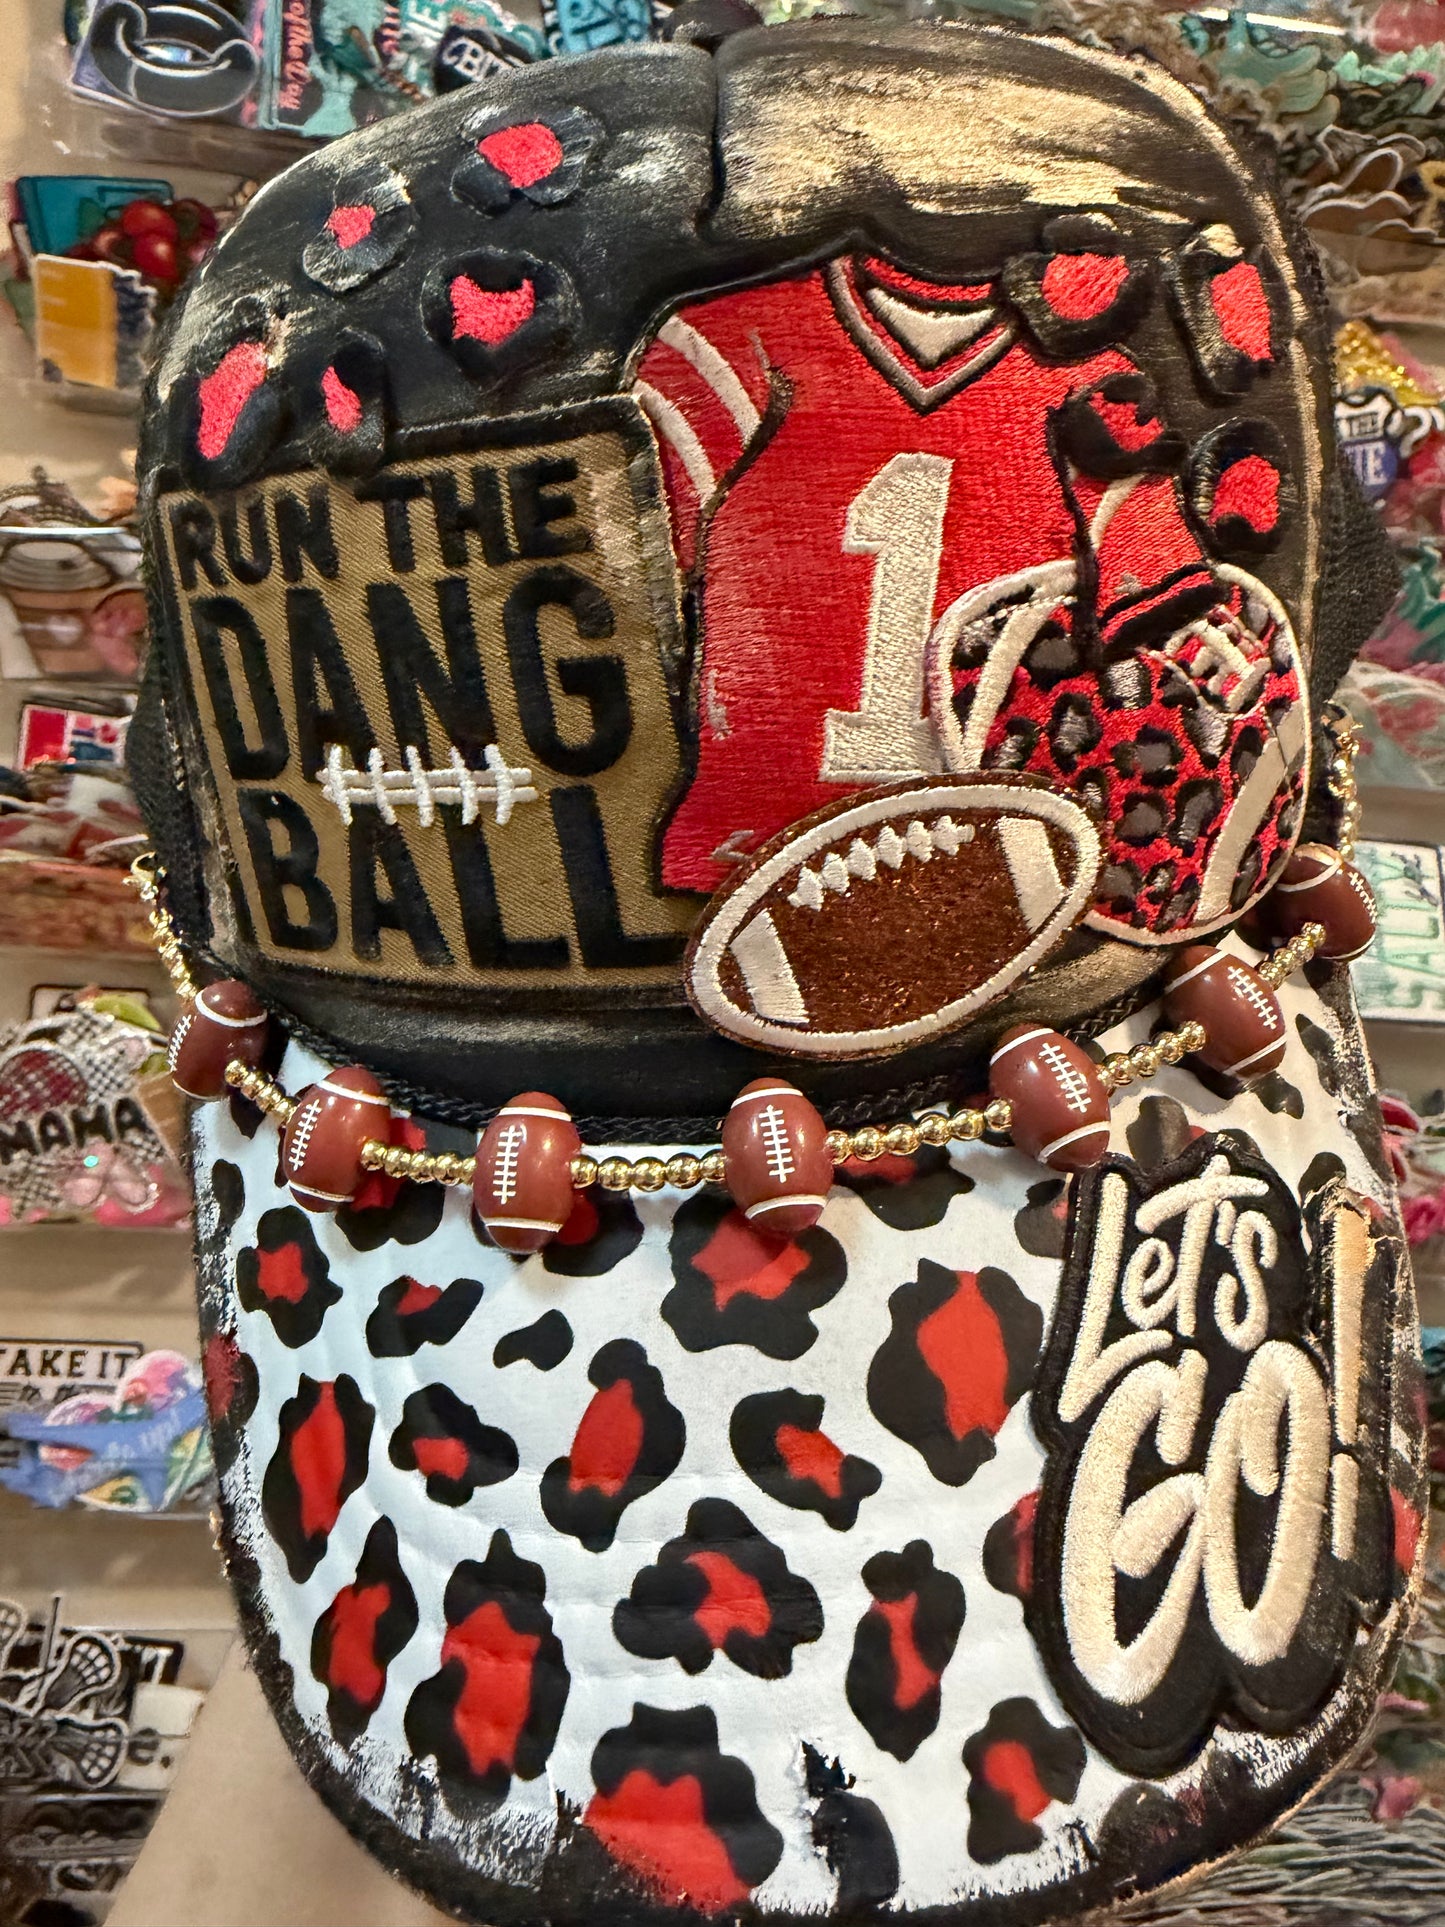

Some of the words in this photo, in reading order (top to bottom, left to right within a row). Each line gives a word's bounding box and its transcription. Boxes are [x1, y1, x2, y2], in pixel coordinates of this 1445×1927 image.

[167, 489, 340, 590] RUN
[355, 457, 596, 573] THE
[189, 566, 634, 783] DANG
[818, 451, 956, 783] 1
[236, 784, 690, 969] BALL
[97, 1351, 134, 1379] IT
